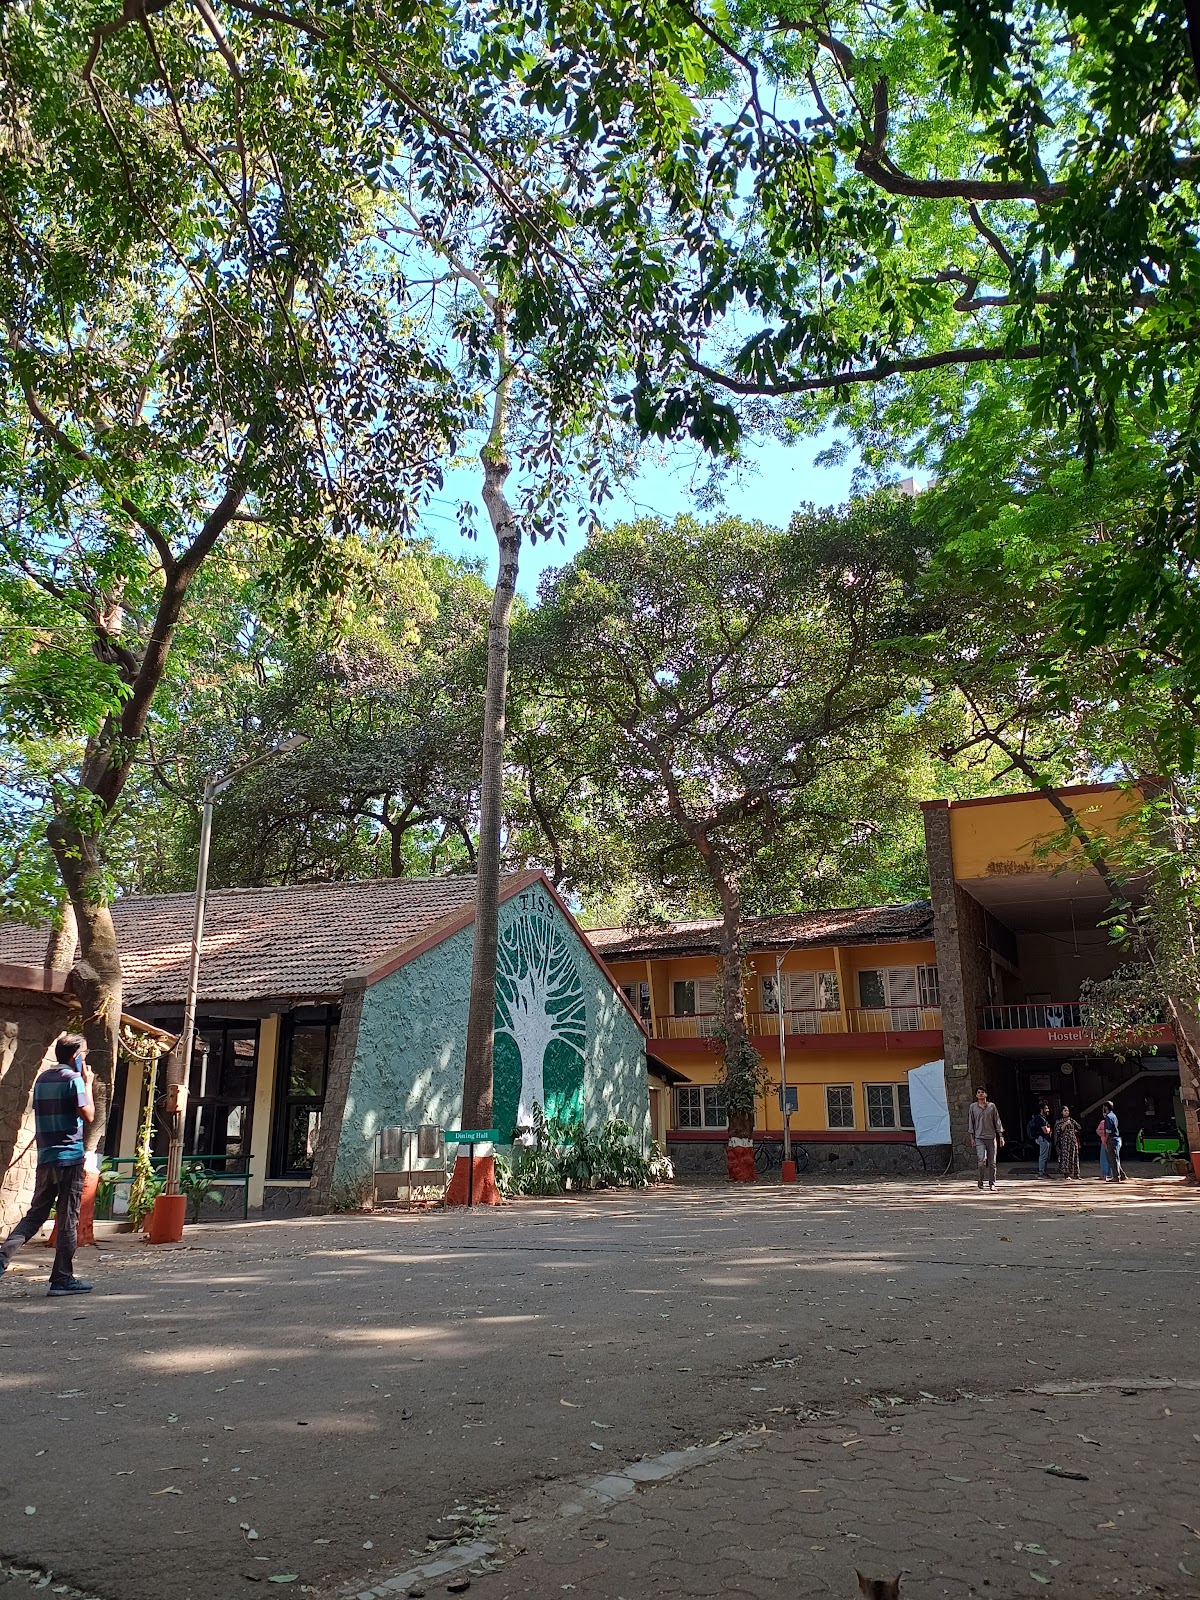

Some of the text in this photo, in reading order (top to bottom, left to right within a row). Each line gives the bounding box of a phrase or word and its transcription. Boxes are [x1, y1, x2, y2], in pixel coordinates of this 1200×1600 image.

[519, 893, 555, 920] TISS
[1048, 1030, 1082, 1041] Hostel
[455, 1132, 475, 1140] Dining
